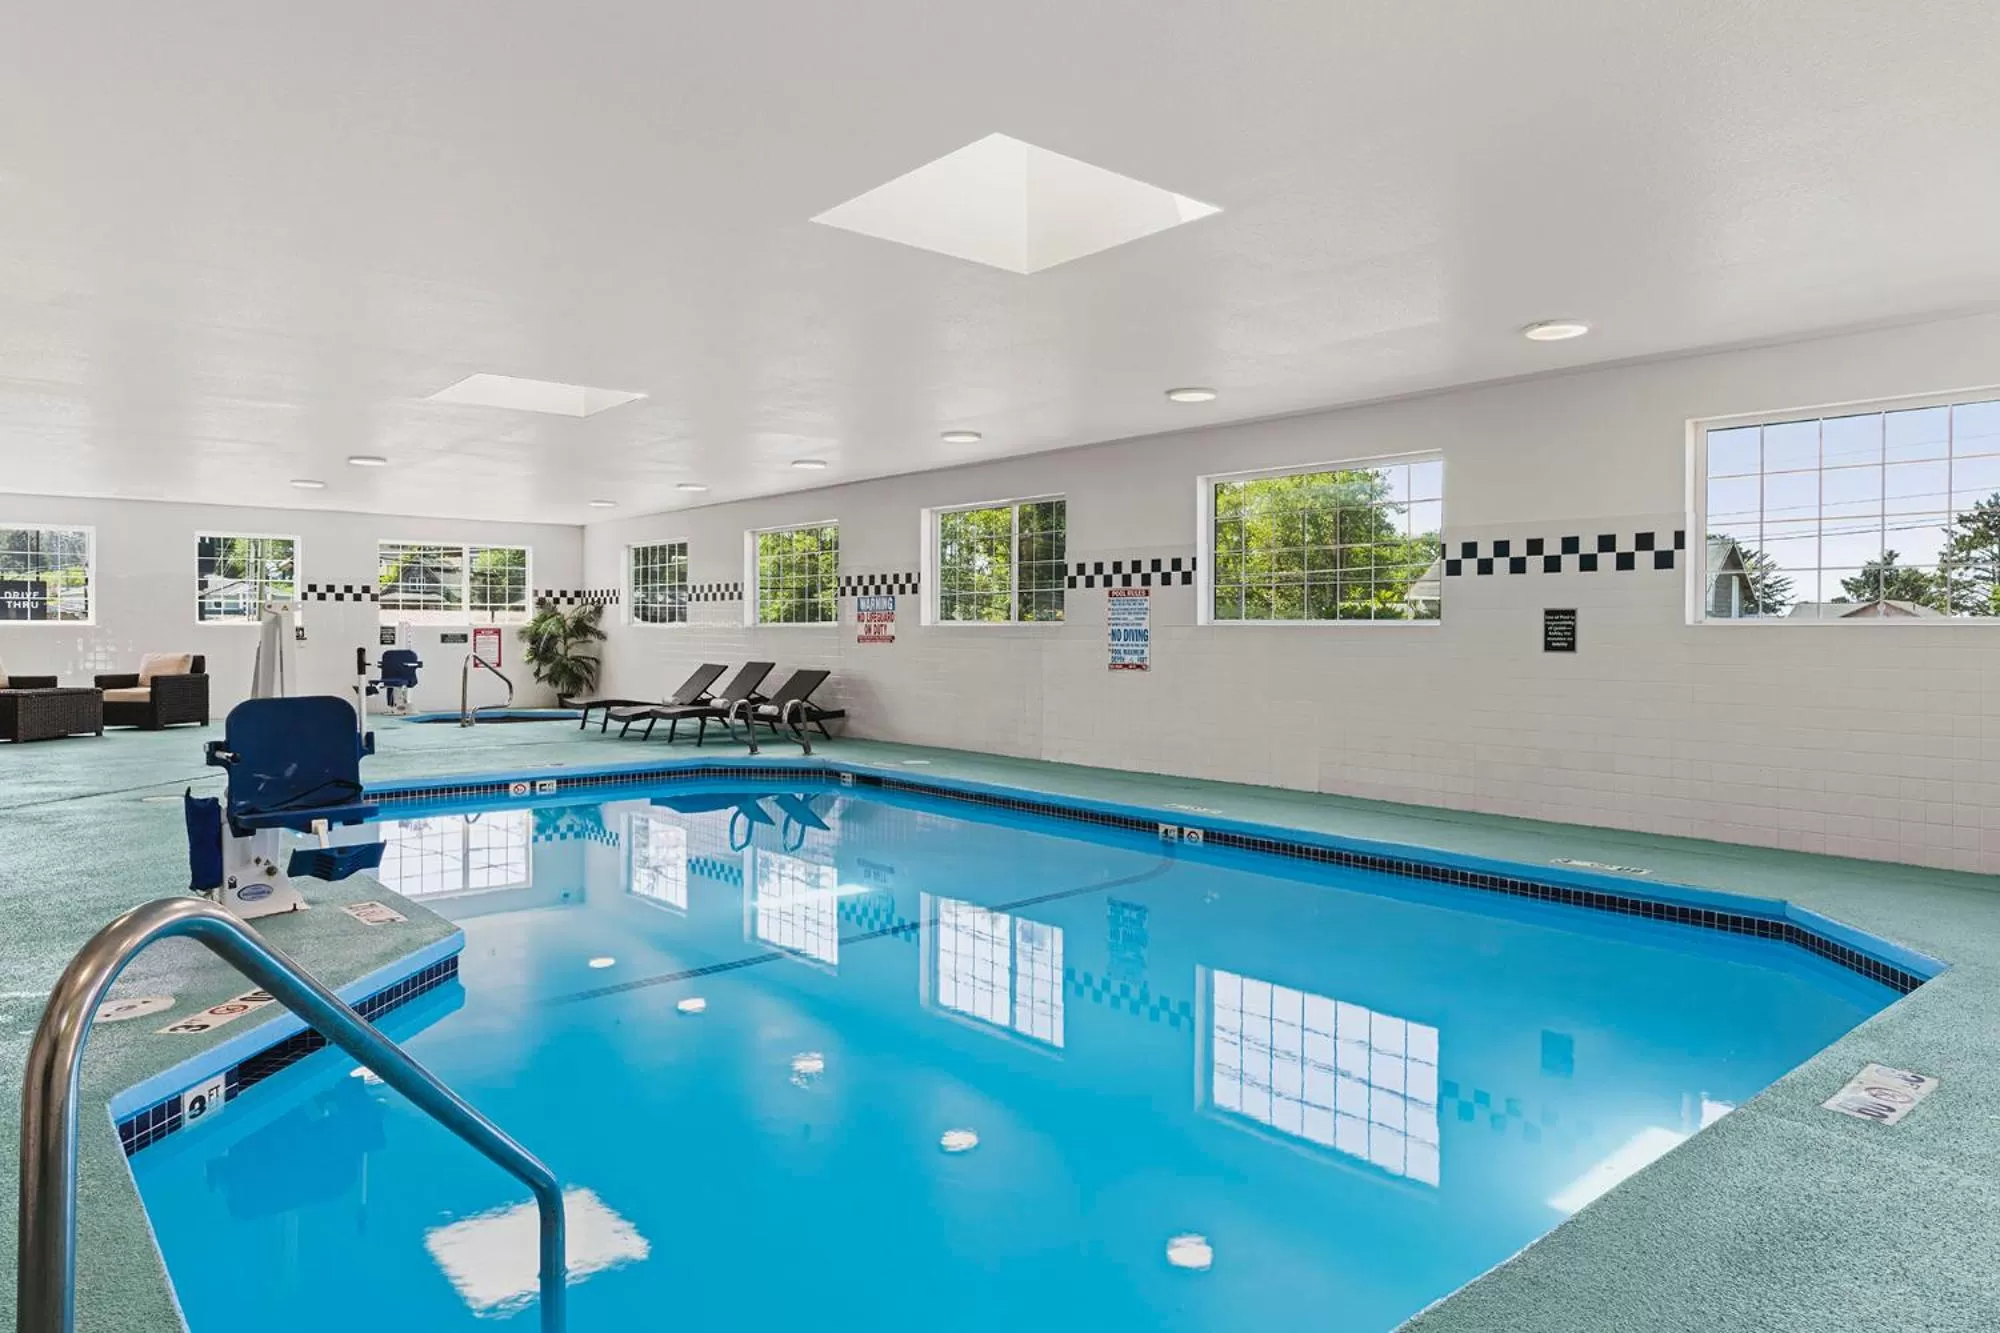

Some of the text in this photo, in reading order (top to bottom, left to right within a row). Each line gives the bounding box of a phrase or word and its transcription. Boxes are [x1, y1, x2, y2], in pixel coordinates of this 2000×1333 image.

[4, 591, 40, 600] DRIVE
[6, 600, 39, 609] THRU
[860, 597, 893, 611] WARNING
[866, 611, 895, 623] LIFEGUARD
[873, 623, 888, 636] DUTY
[1111, 629, 1149, 642] NO DIVING
[208, 1085, 220, 1102] FT
